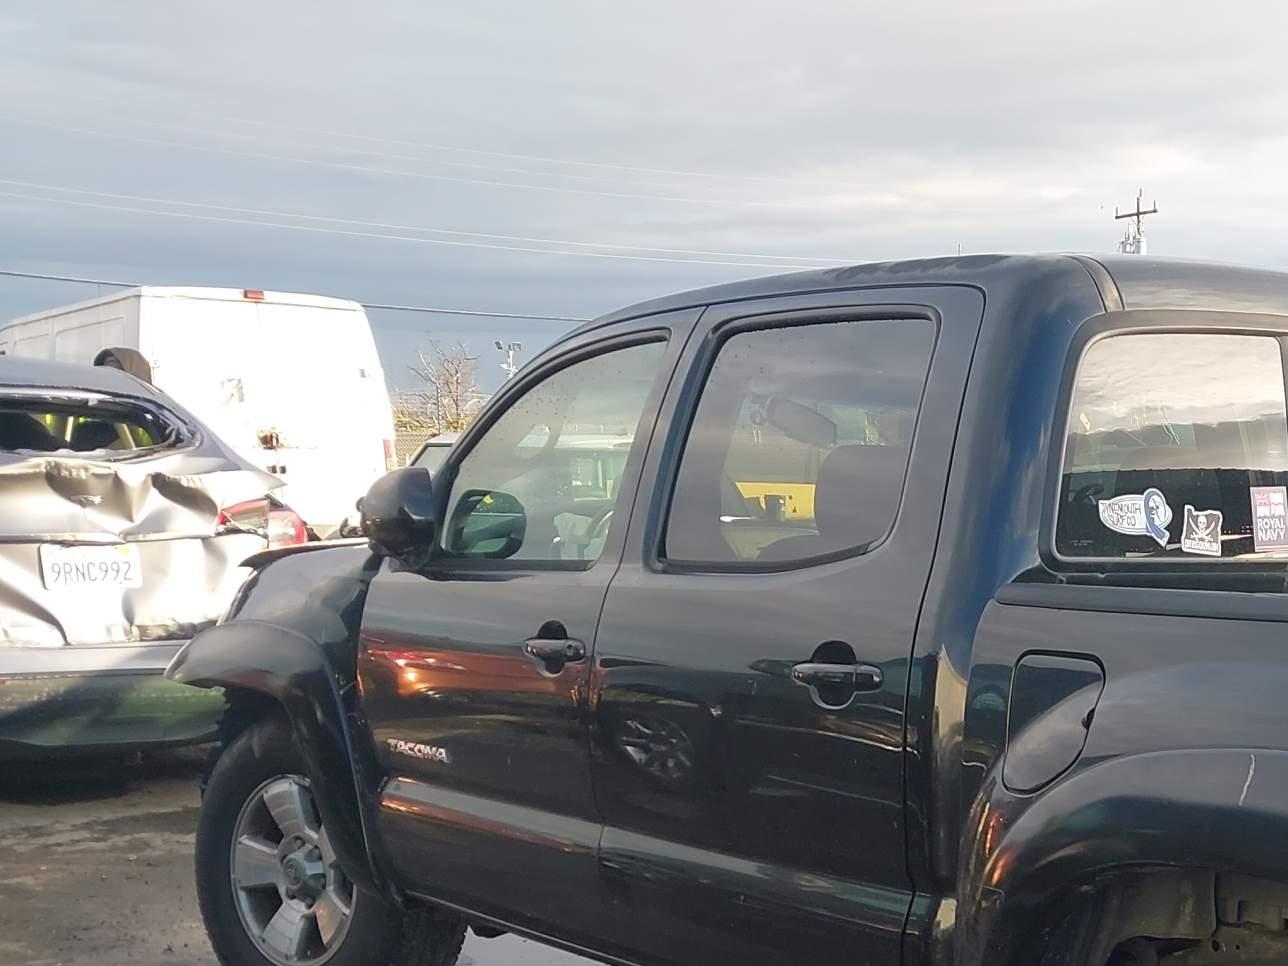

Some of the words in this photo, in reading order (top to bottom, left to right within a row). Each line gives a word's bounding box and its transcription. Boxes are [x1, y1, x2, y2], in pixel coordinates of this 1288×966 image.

[1257, 517, 1286, 529] ROYAL
[1257, 528, 1286, 541] NAVY
[51, 561, 133, 584] 9RNC992
[386, 738, 450, 763] TACOMA
